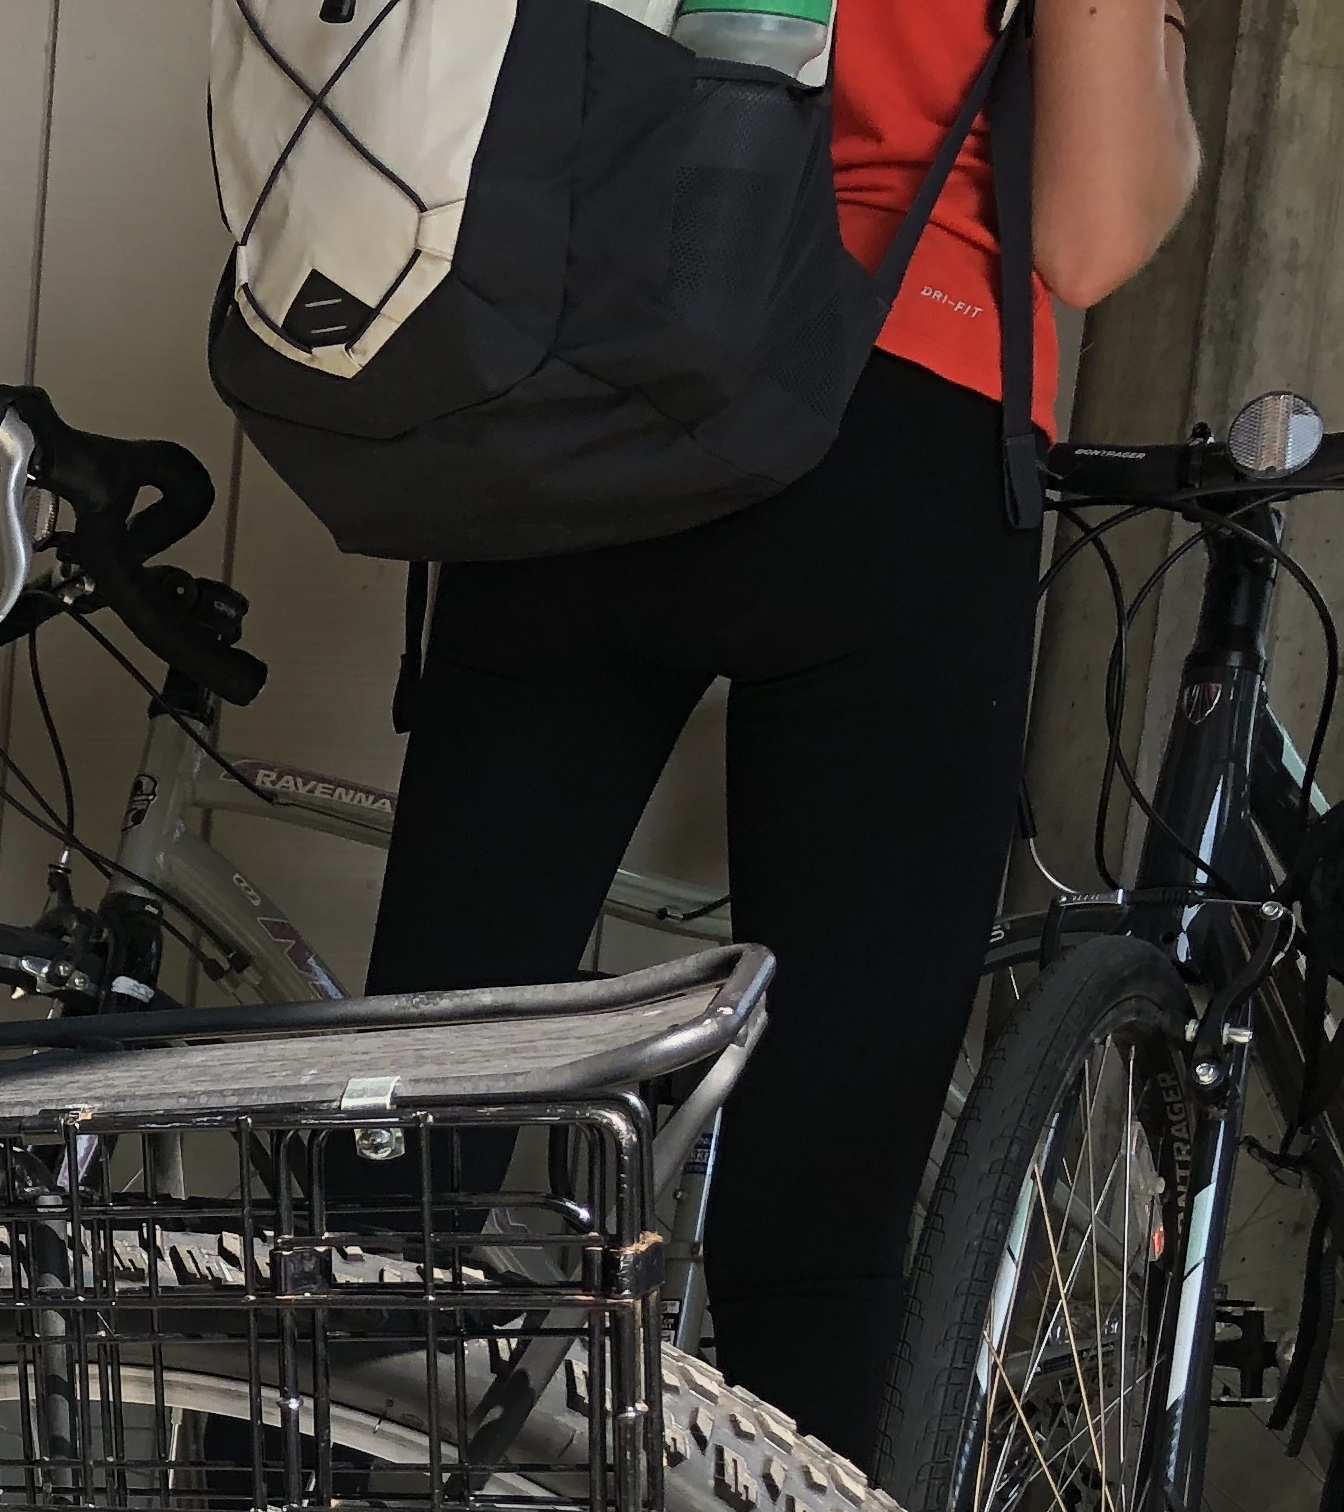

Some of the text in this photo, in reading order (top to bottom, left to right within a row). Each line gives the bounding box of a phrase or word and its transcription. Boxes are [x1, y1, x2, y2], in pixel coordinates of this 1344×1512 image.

[920, 285, 983, 318] DRI-FIT
[1074, 448, 1147, 460] BONTRAGER
[255, 768, 393, 814] RAVENNA
